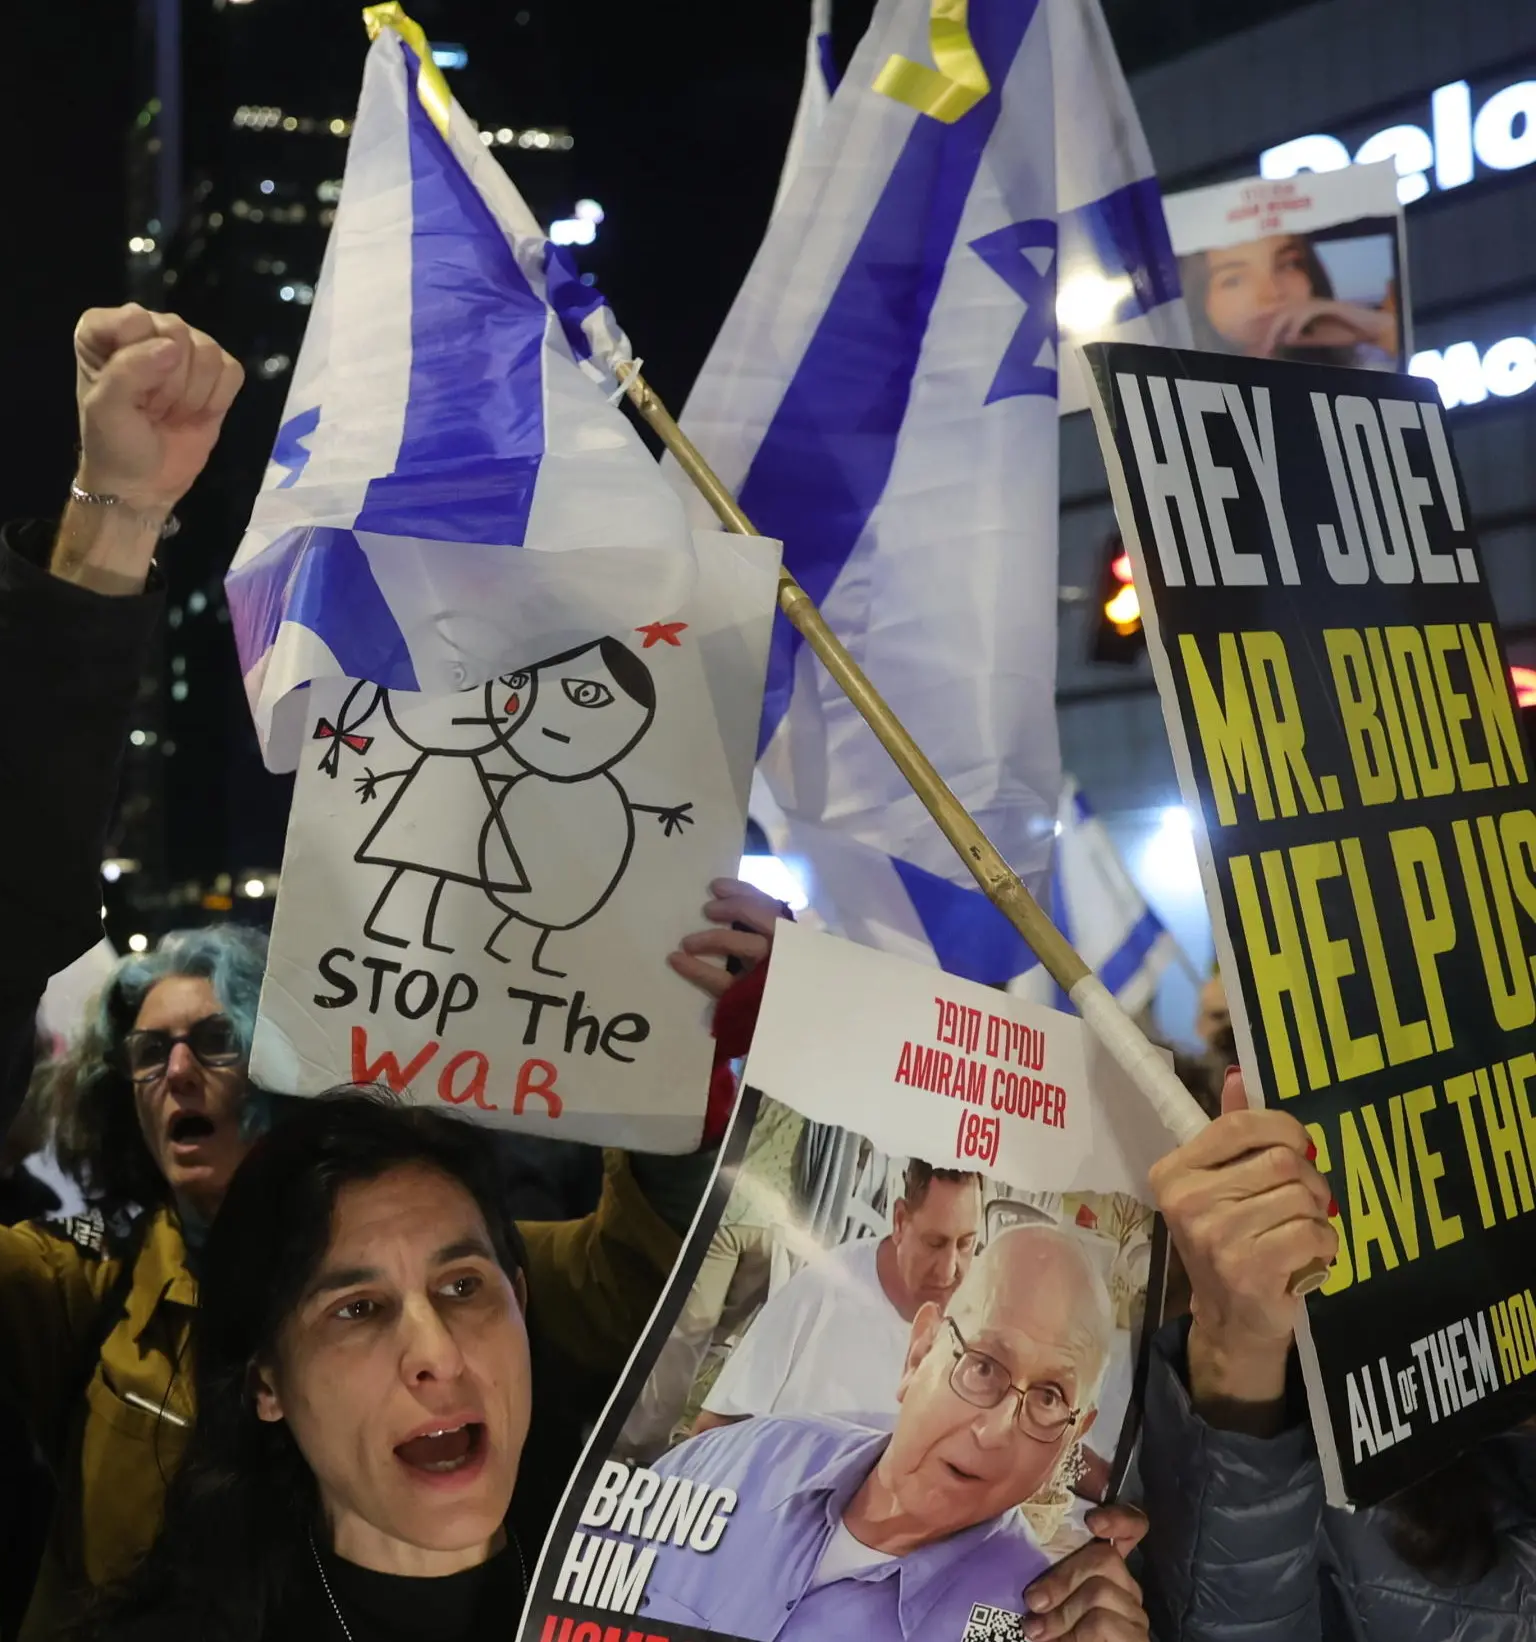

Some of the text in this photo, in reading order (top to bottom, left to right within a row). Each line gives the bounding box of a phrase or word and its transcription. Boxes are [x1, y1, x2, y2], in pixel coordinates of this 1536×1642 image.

[1115, 372, 1480, 587] HEY JOE!
[1178, 623, 1528, 826] MR. BIDEN
[313, 947, 650, 1063] STOP The
[1229, 825, 1453, 1100] HELP
[895, 1041, 1067, 1129] AMIRAM COOPER
[935, 997, 1045, 1071] עמירם קופר
[956, 1109, 1000, 1168] (85)
[1346, 1355, 1412, 1465] ALL
[1397, 1365, 1418, 1415] OF
[1410, 1311, 1499, 1424] THEM
[579, 1459, 737, 1553] BRING
[552, 1531, 658, 1615] HIM
